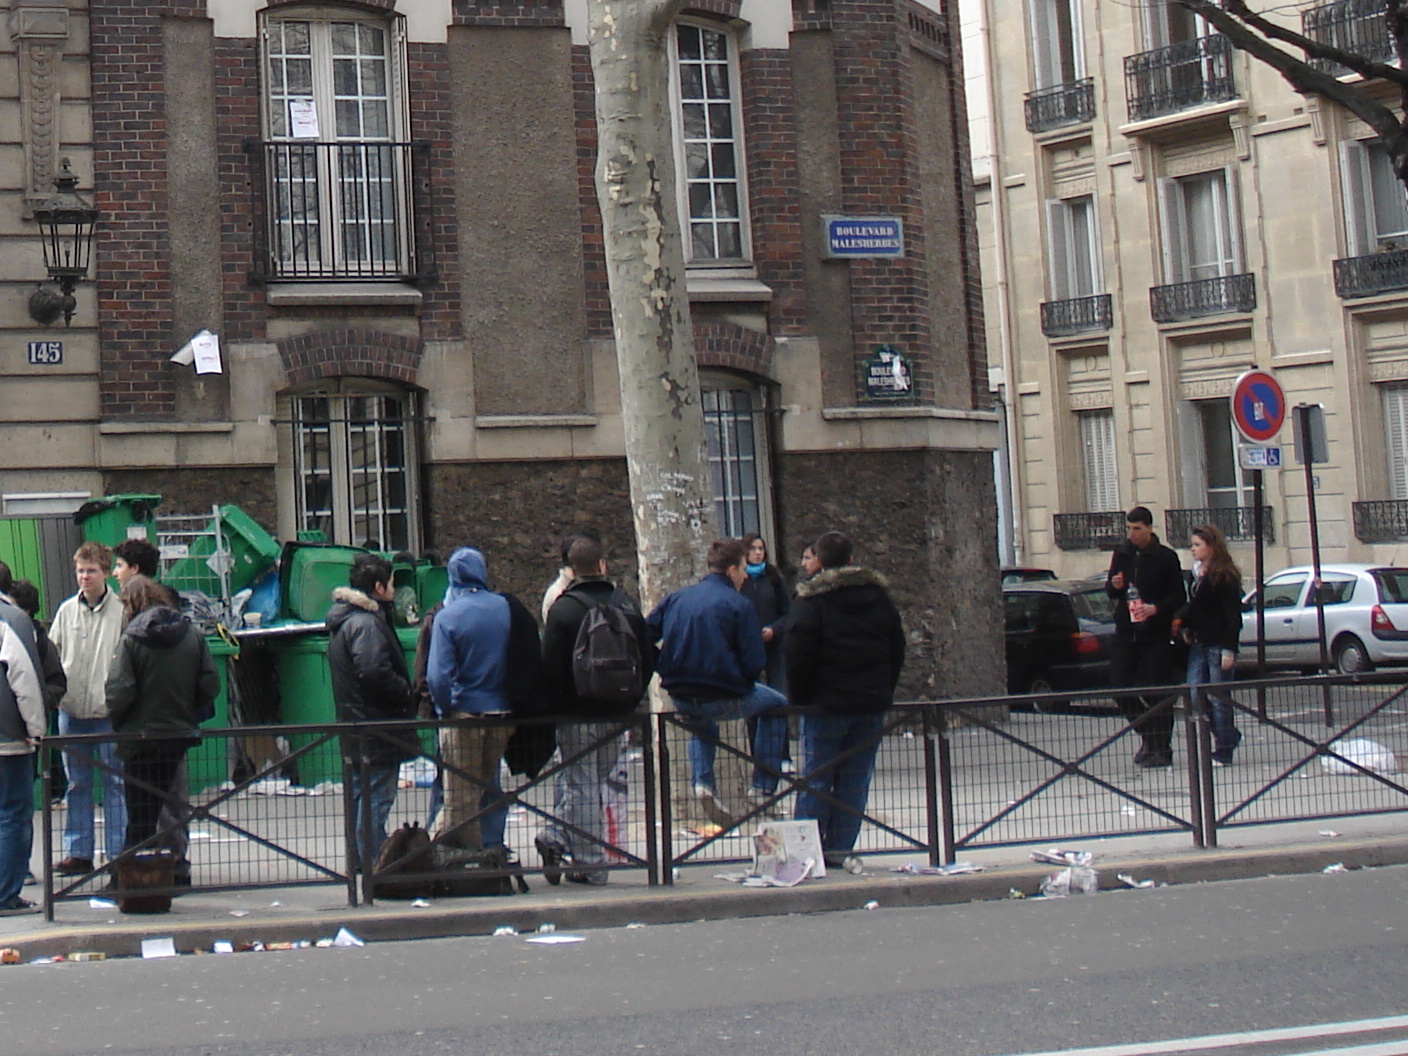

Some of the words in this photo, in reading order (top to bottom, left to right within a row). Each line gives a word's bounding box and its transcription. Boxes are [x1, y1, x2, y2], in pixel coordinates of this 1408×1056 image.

[836, 226, 894, 236] BOULEVARD
[831, 238, 900, 248] MALESHERBES
[30, 342, 61, 363] 145
